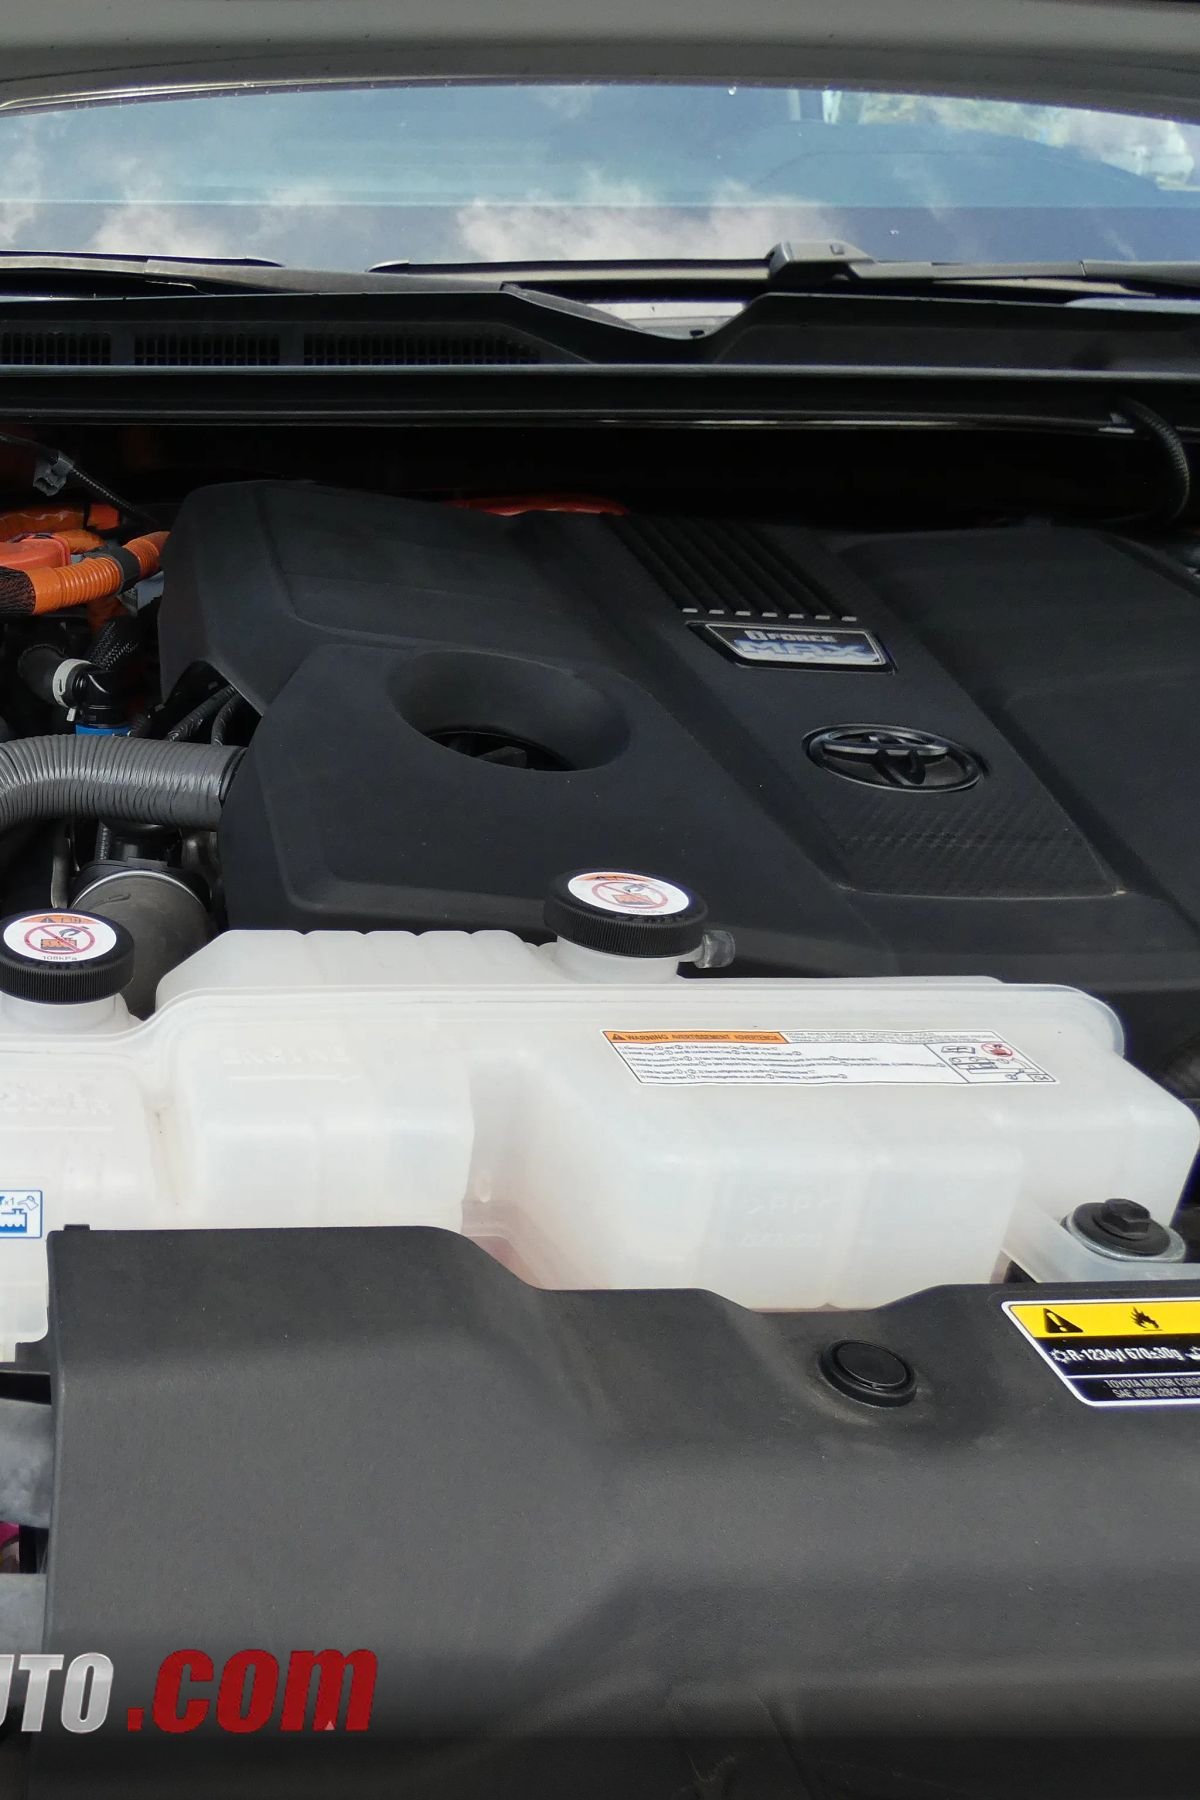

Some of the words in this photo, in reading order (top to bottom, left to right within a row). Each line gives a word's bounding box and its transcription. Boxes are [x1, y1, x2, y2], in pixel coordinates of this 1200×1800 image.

[1104, 1379, 1143, 1389] TOYOTA
[1140, 1378, 1177, 1388] MOTOR
[1112, 1389, 1135, 1398] SAE
